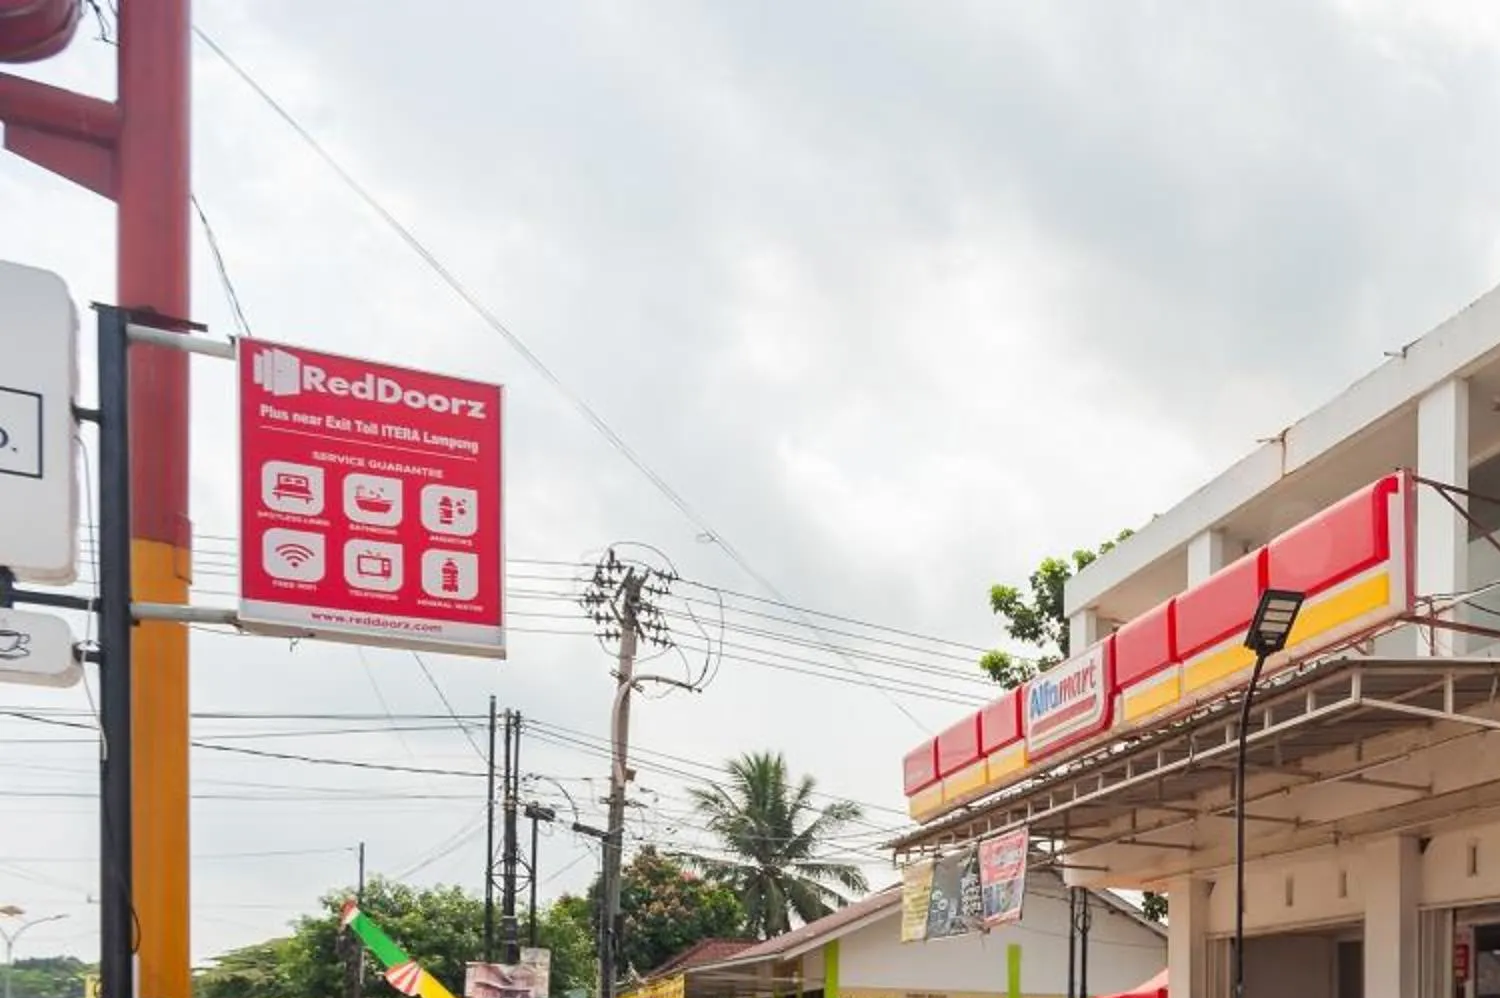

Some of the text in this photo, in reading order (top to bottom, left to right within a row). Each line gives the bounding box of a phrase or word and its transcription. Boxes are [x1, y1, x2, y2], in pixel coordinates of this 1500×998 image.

[303, 365, 487, 419] RedDoorz
[259, 404, 290, 421] Plus
[292, 411, 323, 426] near
[326, 415, 351, 432] Exit
[381, 424, 421, 442] ITERA
[312, 450, 445, 479] SERVICE GUARANTEE
[311, 612, 444, 633] www.reddoorz.com
[1030, 658, 1098, 719] Alfamart
